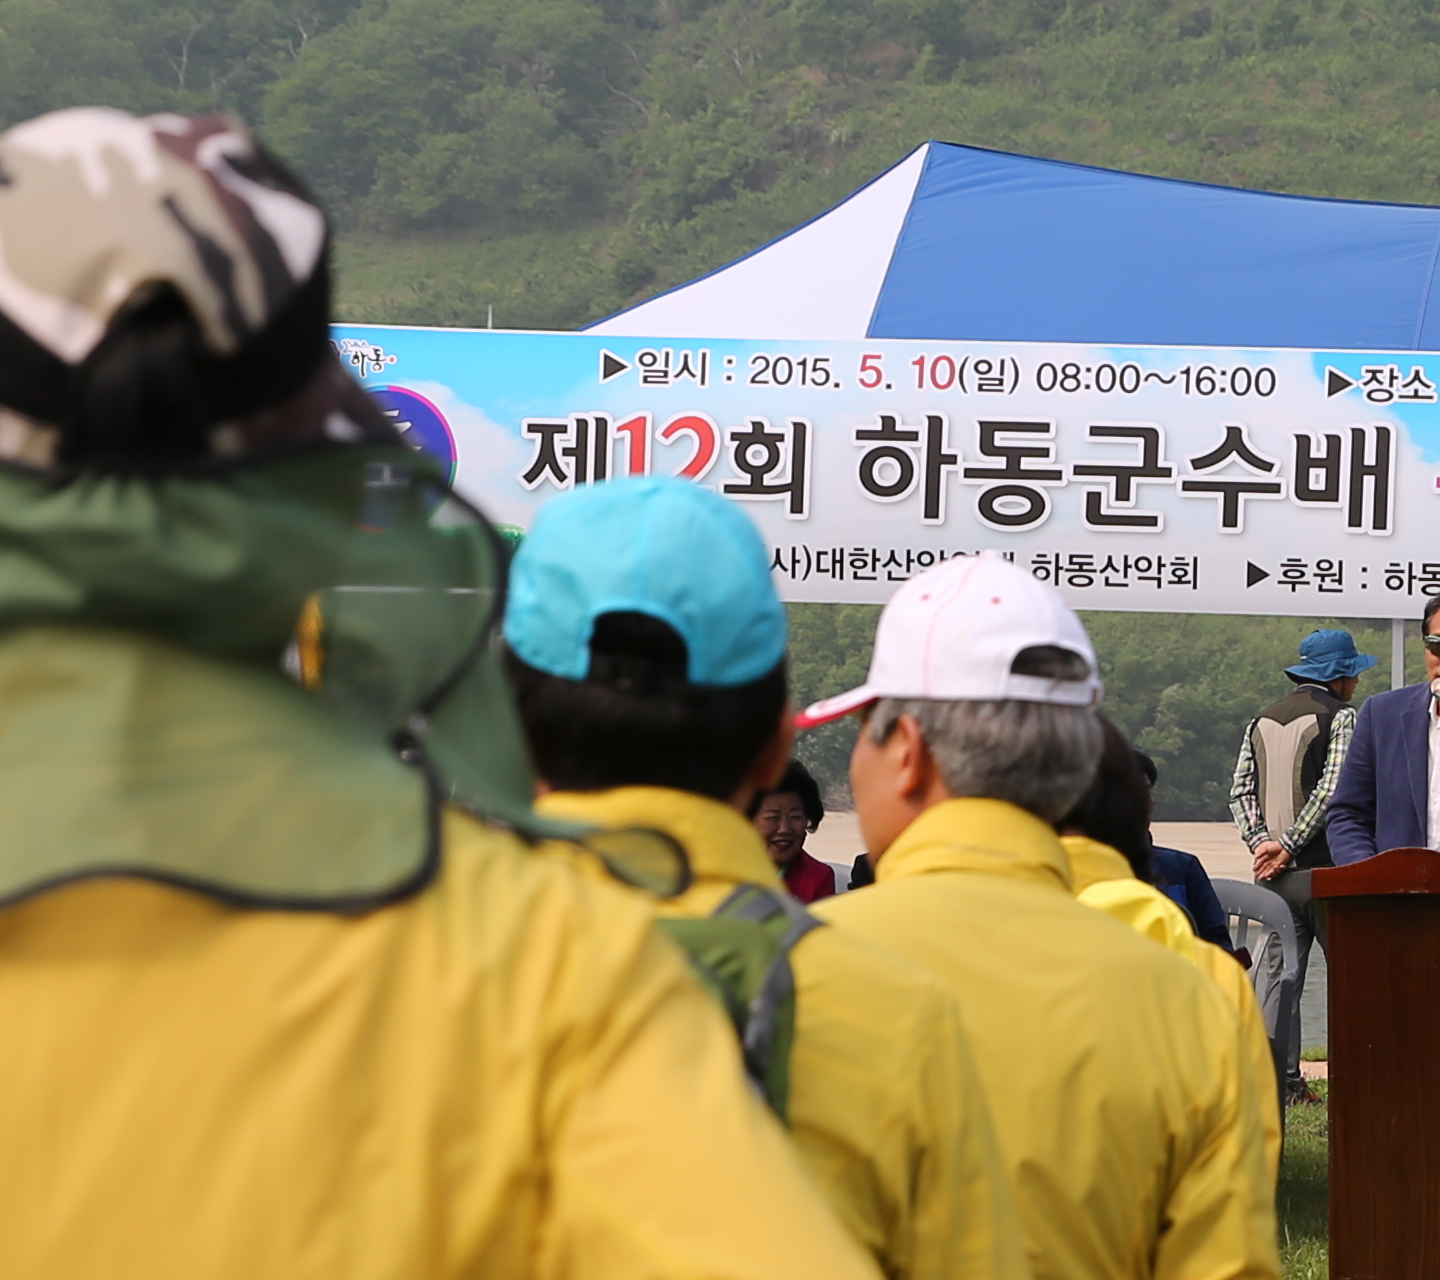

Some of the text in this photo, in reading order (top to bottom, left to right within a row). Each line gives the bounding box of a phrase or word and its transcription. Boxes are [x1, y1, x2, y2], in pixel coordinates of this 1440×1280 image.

[639, 351, 707, 386] 일시
[750, 356, 841, 389] 2015.
[859, 354, 893, 390] 5.
[912, 354, 1019, 395] 10(일)
[1036, 362, 1277, 397] 08:00~16:00
[1362, 367, 1434, 403] 장소
[522, 416, 807, 514] 제12회
[855, 415, 1391, 530] 하동군수배
[1031, 552, 1198, 591] 하동산악회
[1277, 558, 1345, 593] 후원
